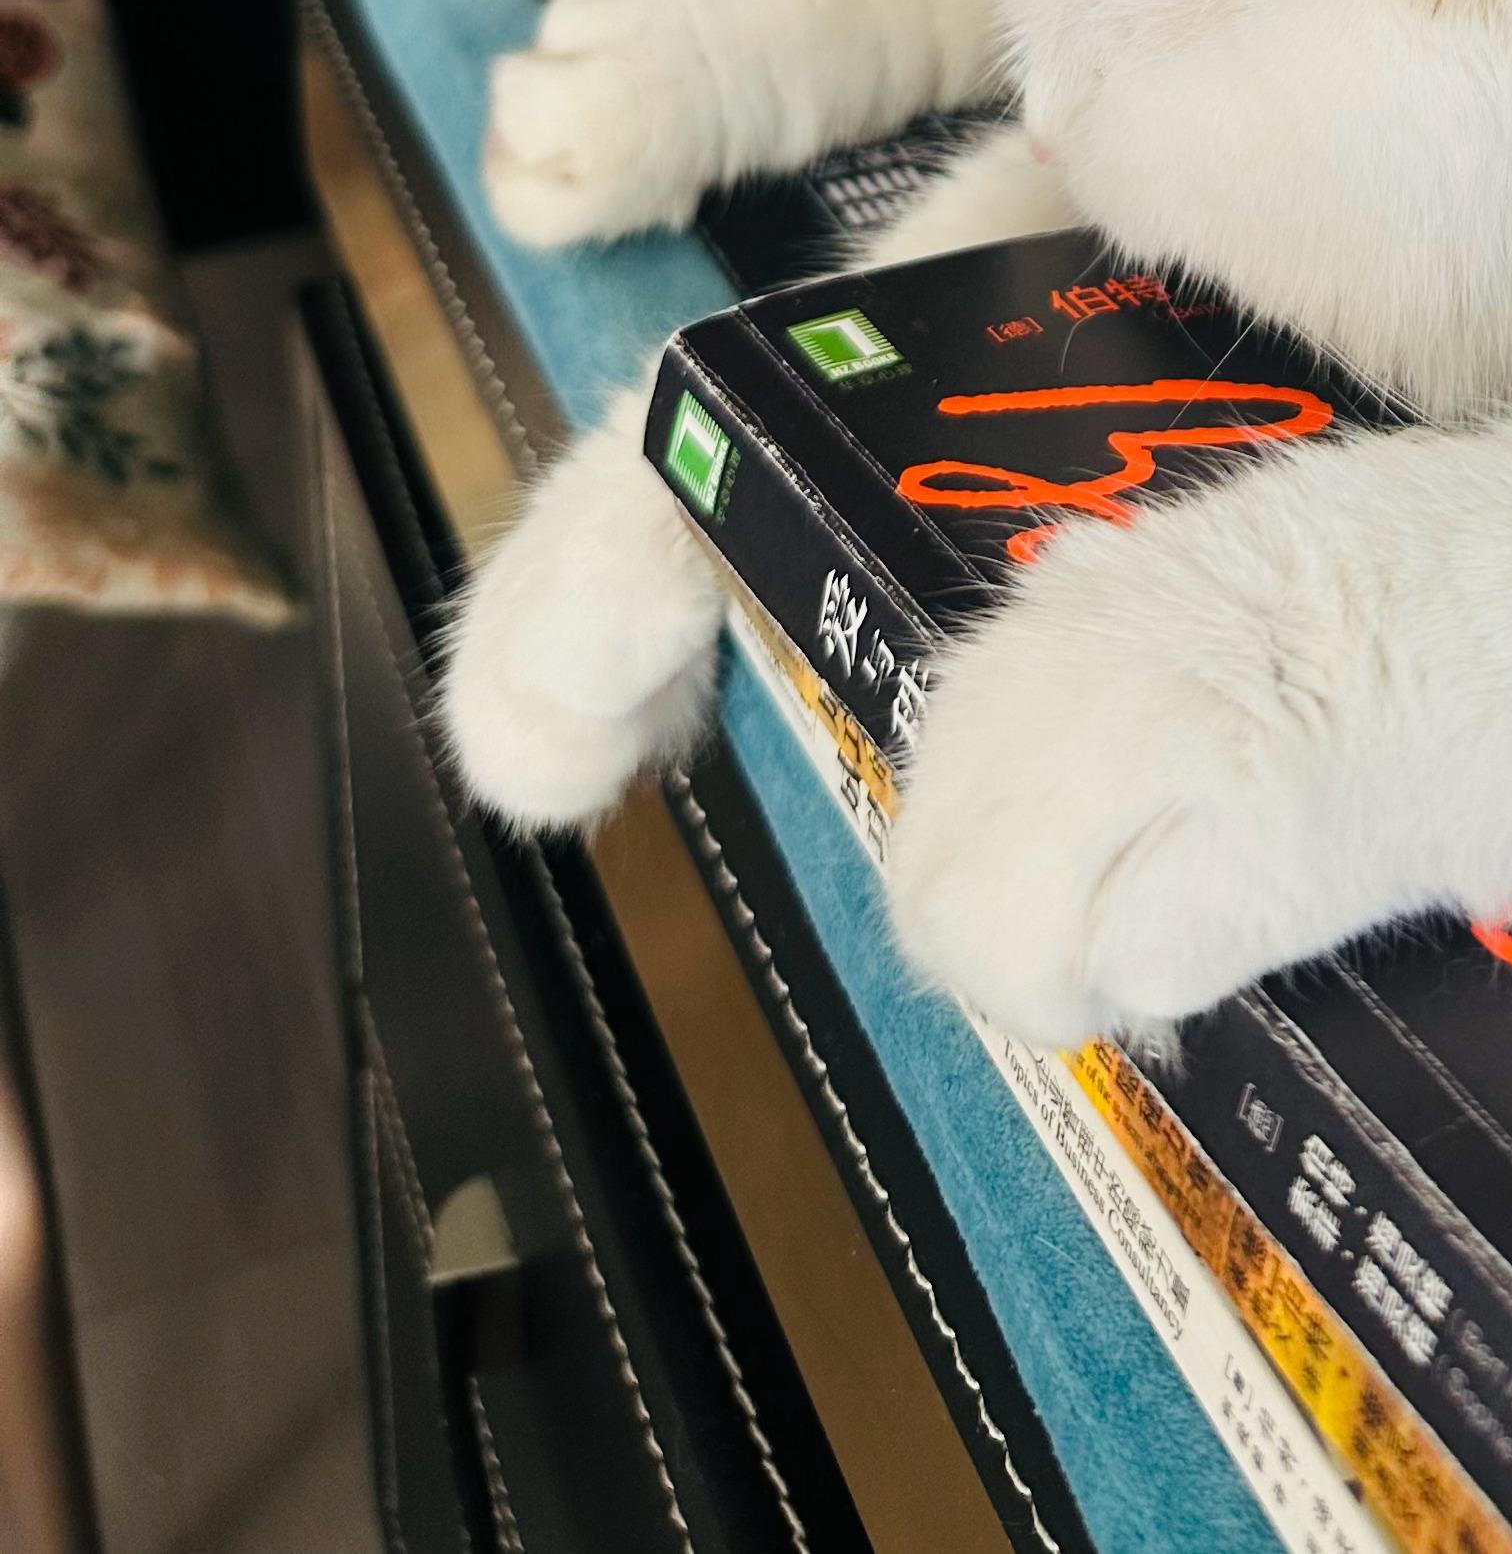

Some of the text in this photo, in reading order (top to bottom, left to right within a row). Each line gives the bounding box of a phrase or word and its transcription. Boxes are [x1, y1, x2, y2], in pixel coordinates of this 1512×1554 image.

[1002, 1034, 1038, 1107] Topics
[1041, 1103, 1057, 1127] of
[1055, 1122, 1106, 1214] Business
[1107, 1208, 1184, 1340] Consultancy
